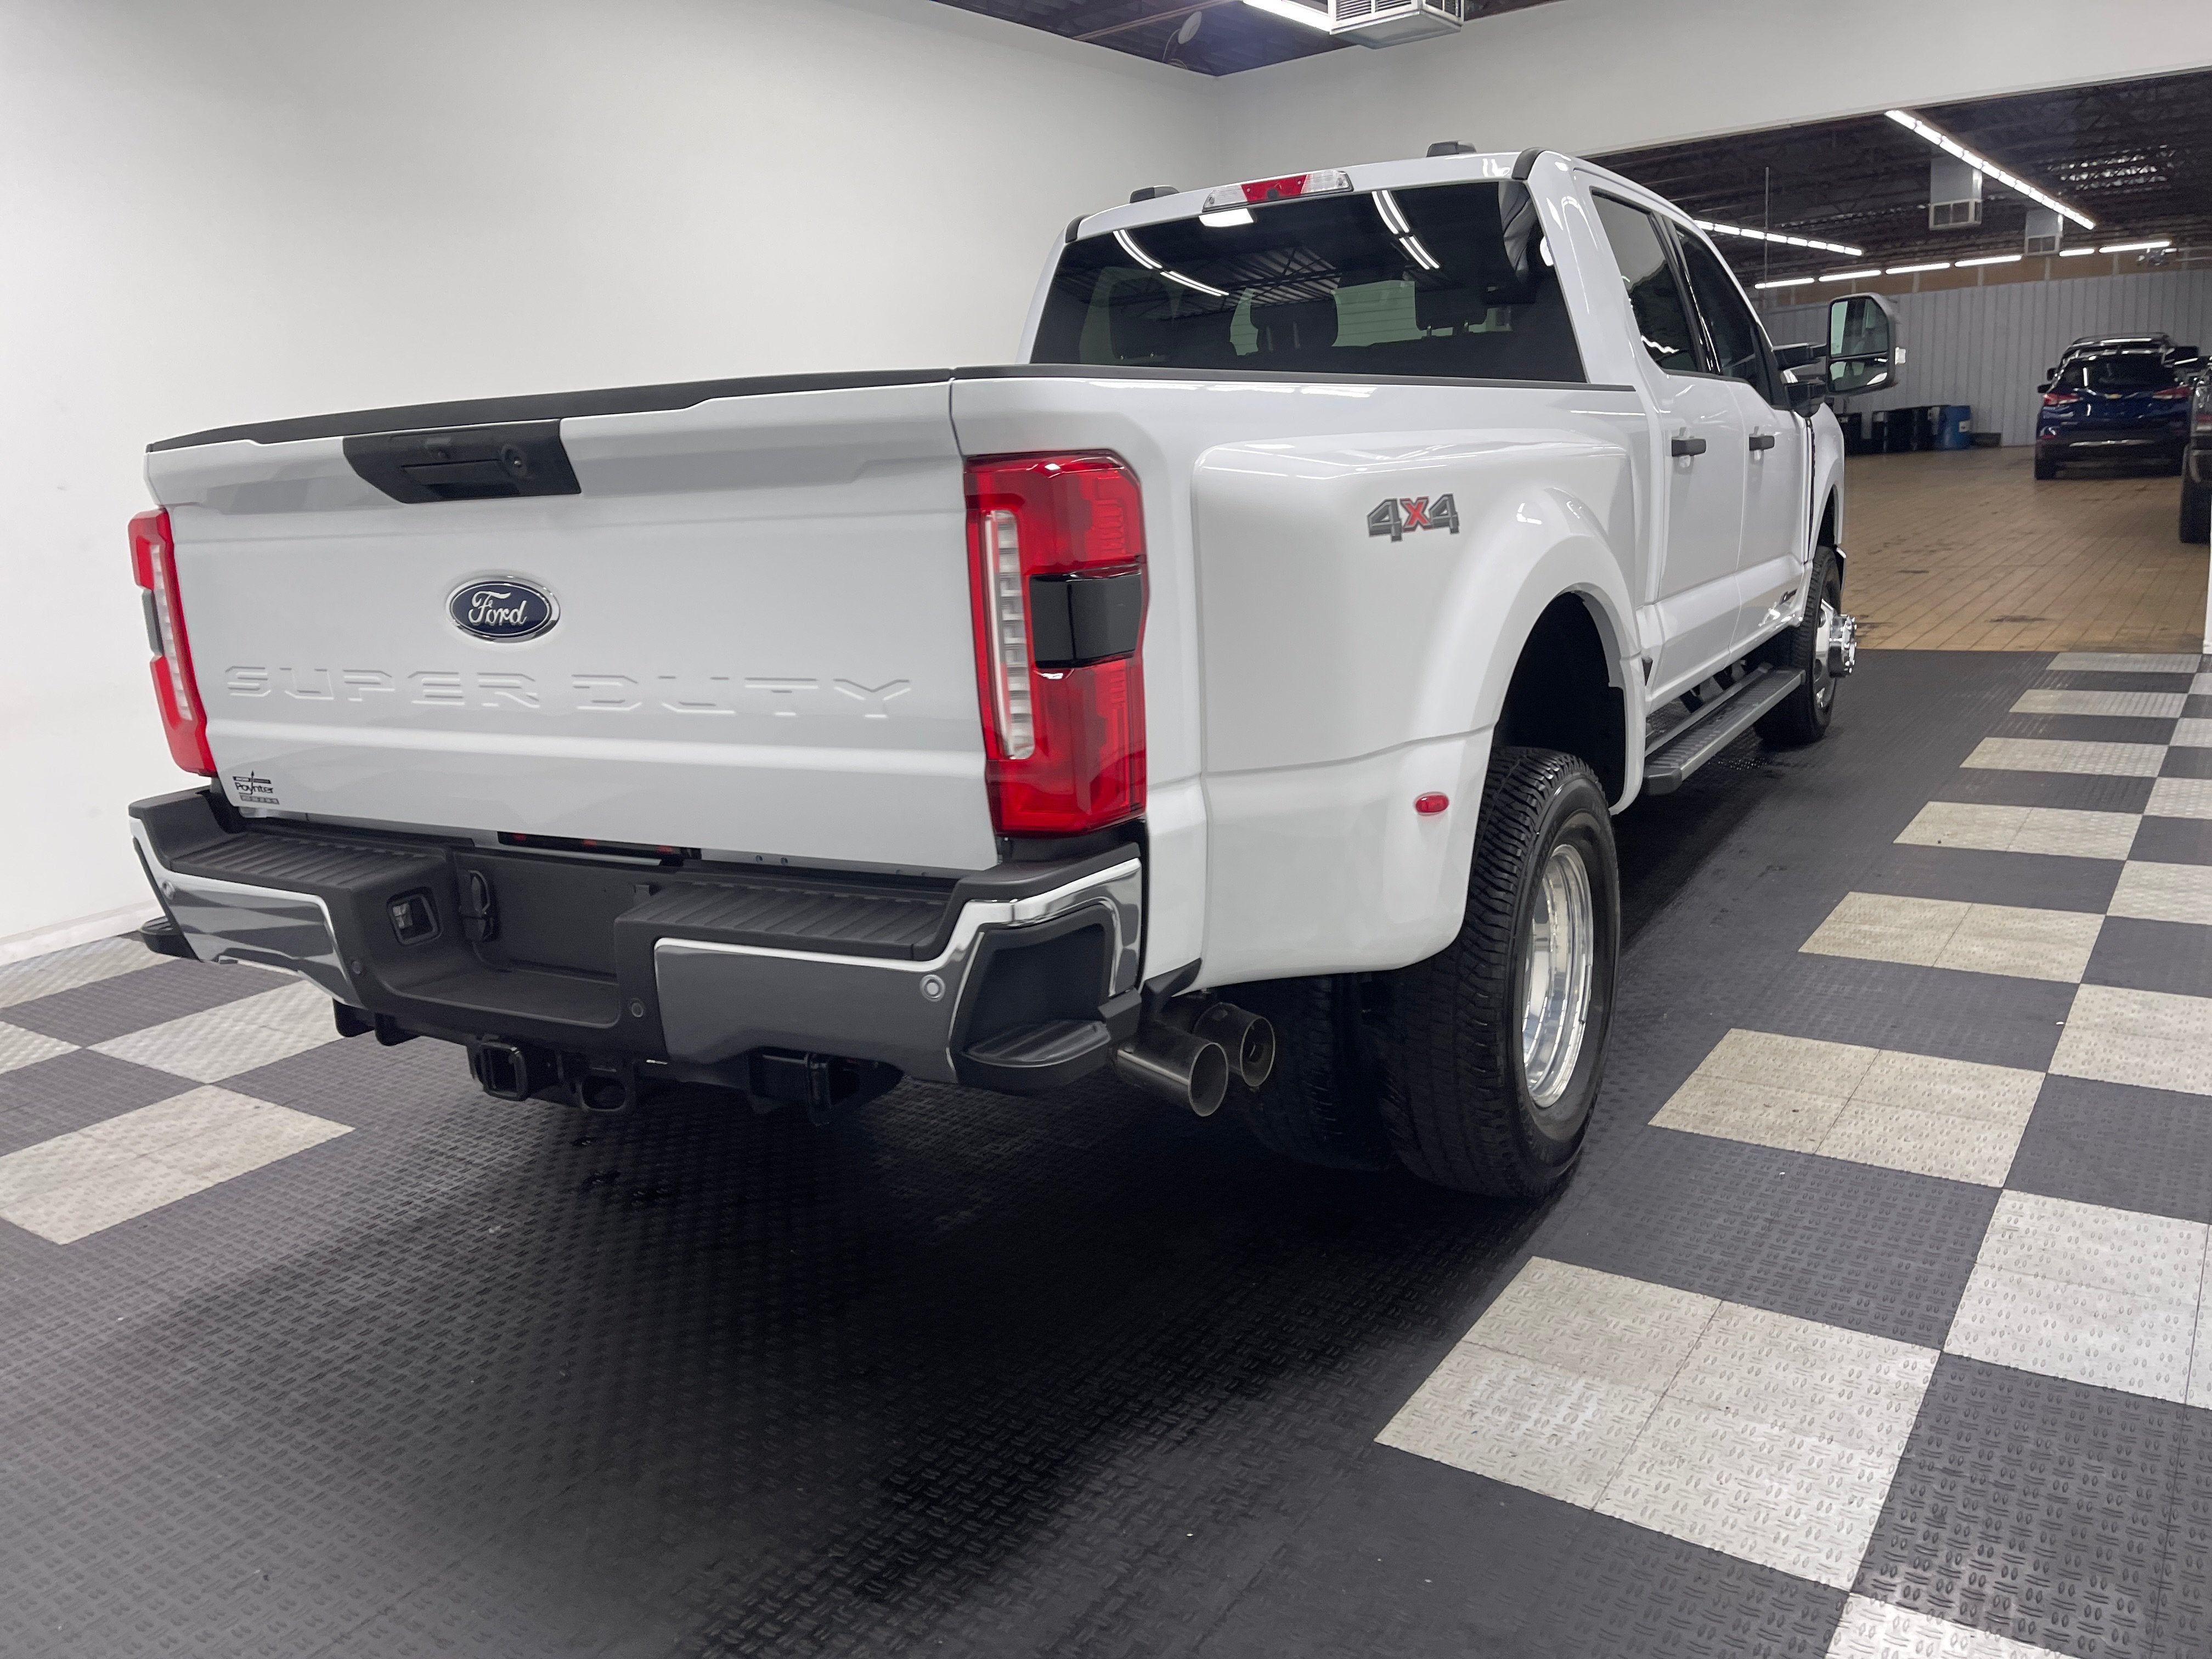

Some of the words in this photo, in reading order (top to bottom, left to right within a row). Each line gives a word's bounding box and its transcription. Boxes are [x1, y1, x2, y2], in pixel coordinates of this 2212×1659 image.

[468, 590, 527, 625] Ford
[224, 665, 540, 708] SUPER
[571, 674, 911, 718] DUTY
